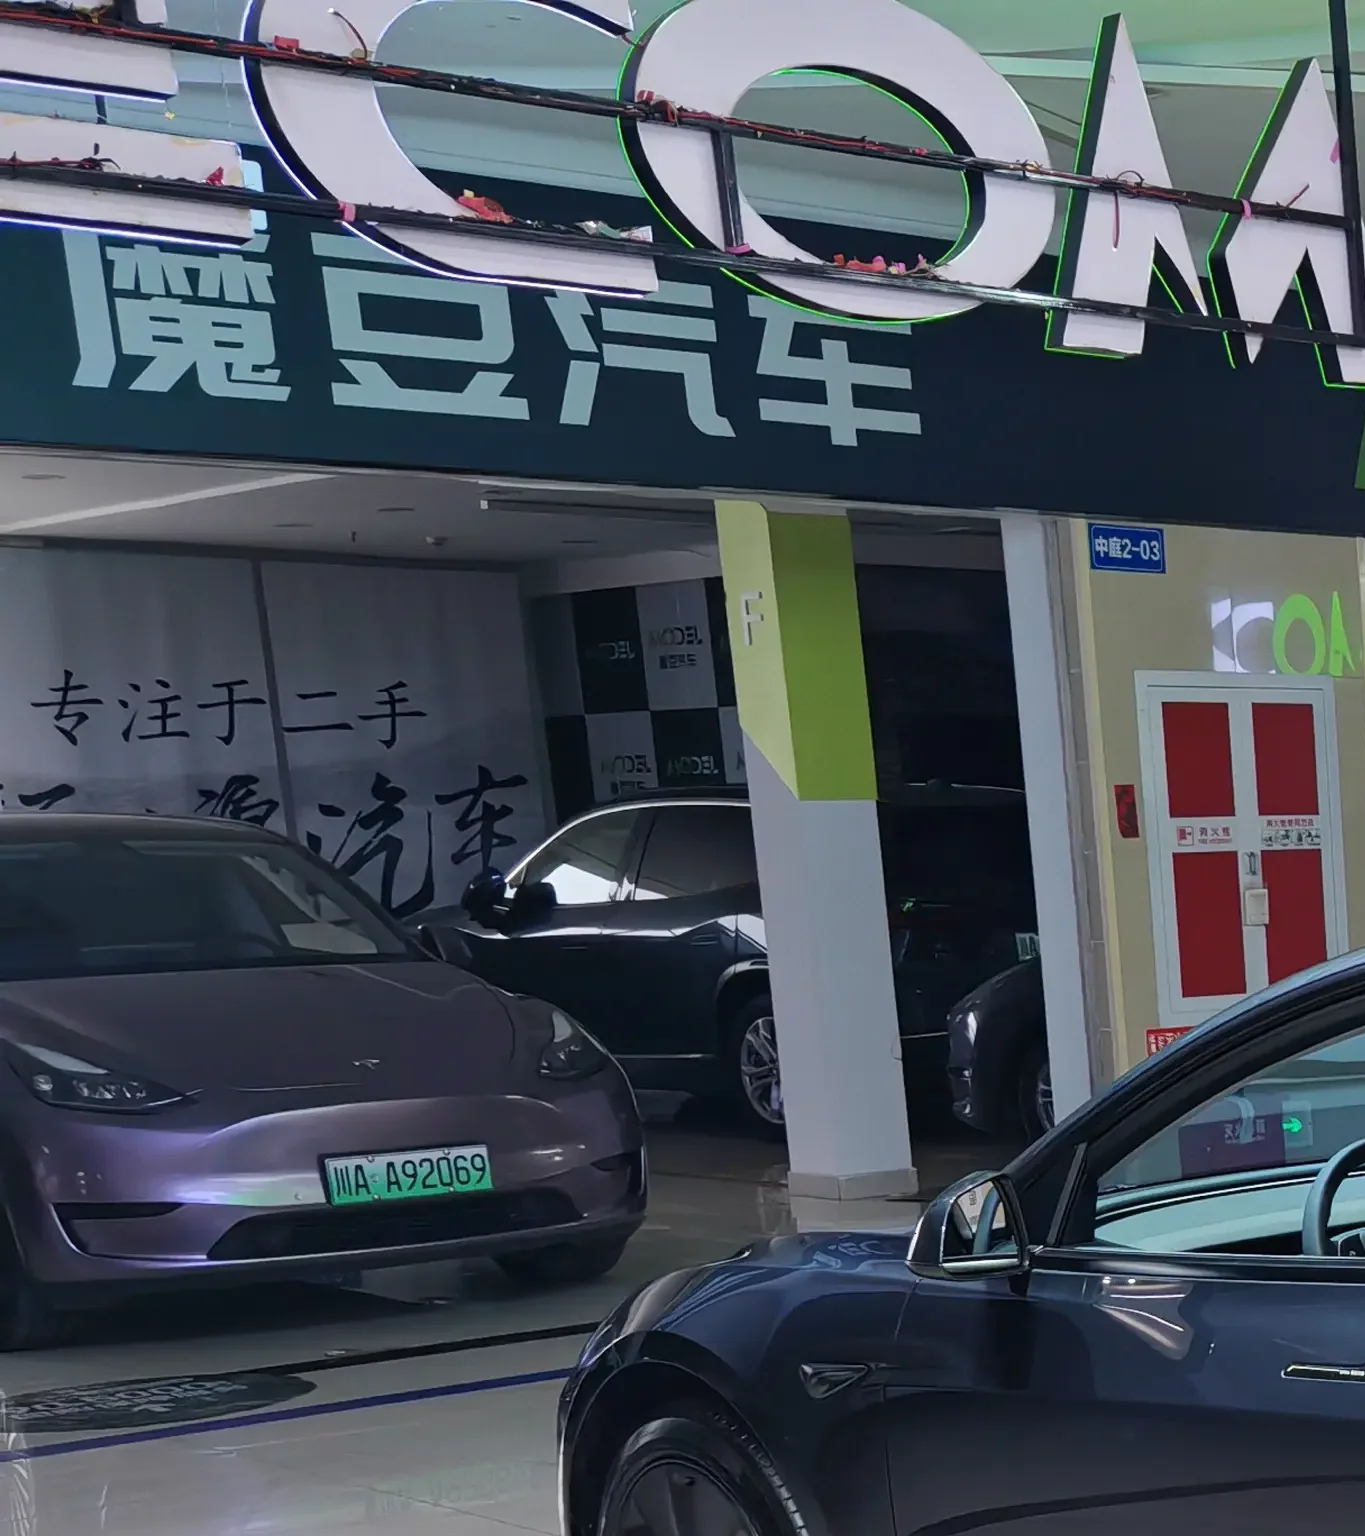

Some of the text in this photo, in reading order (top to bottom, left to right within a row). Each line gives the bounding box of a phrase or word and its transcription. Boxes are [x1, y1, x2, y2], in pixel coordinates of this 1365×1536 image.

[62, 160, 922, 447] 魔豆汽车
[1095, 533, 1161, 562] 中庭2-03
[742, 591, 765, 646] F
[31, 669, 428, 748] 专注于二手
[334, 1153, 486, 1198] 川A A92069
